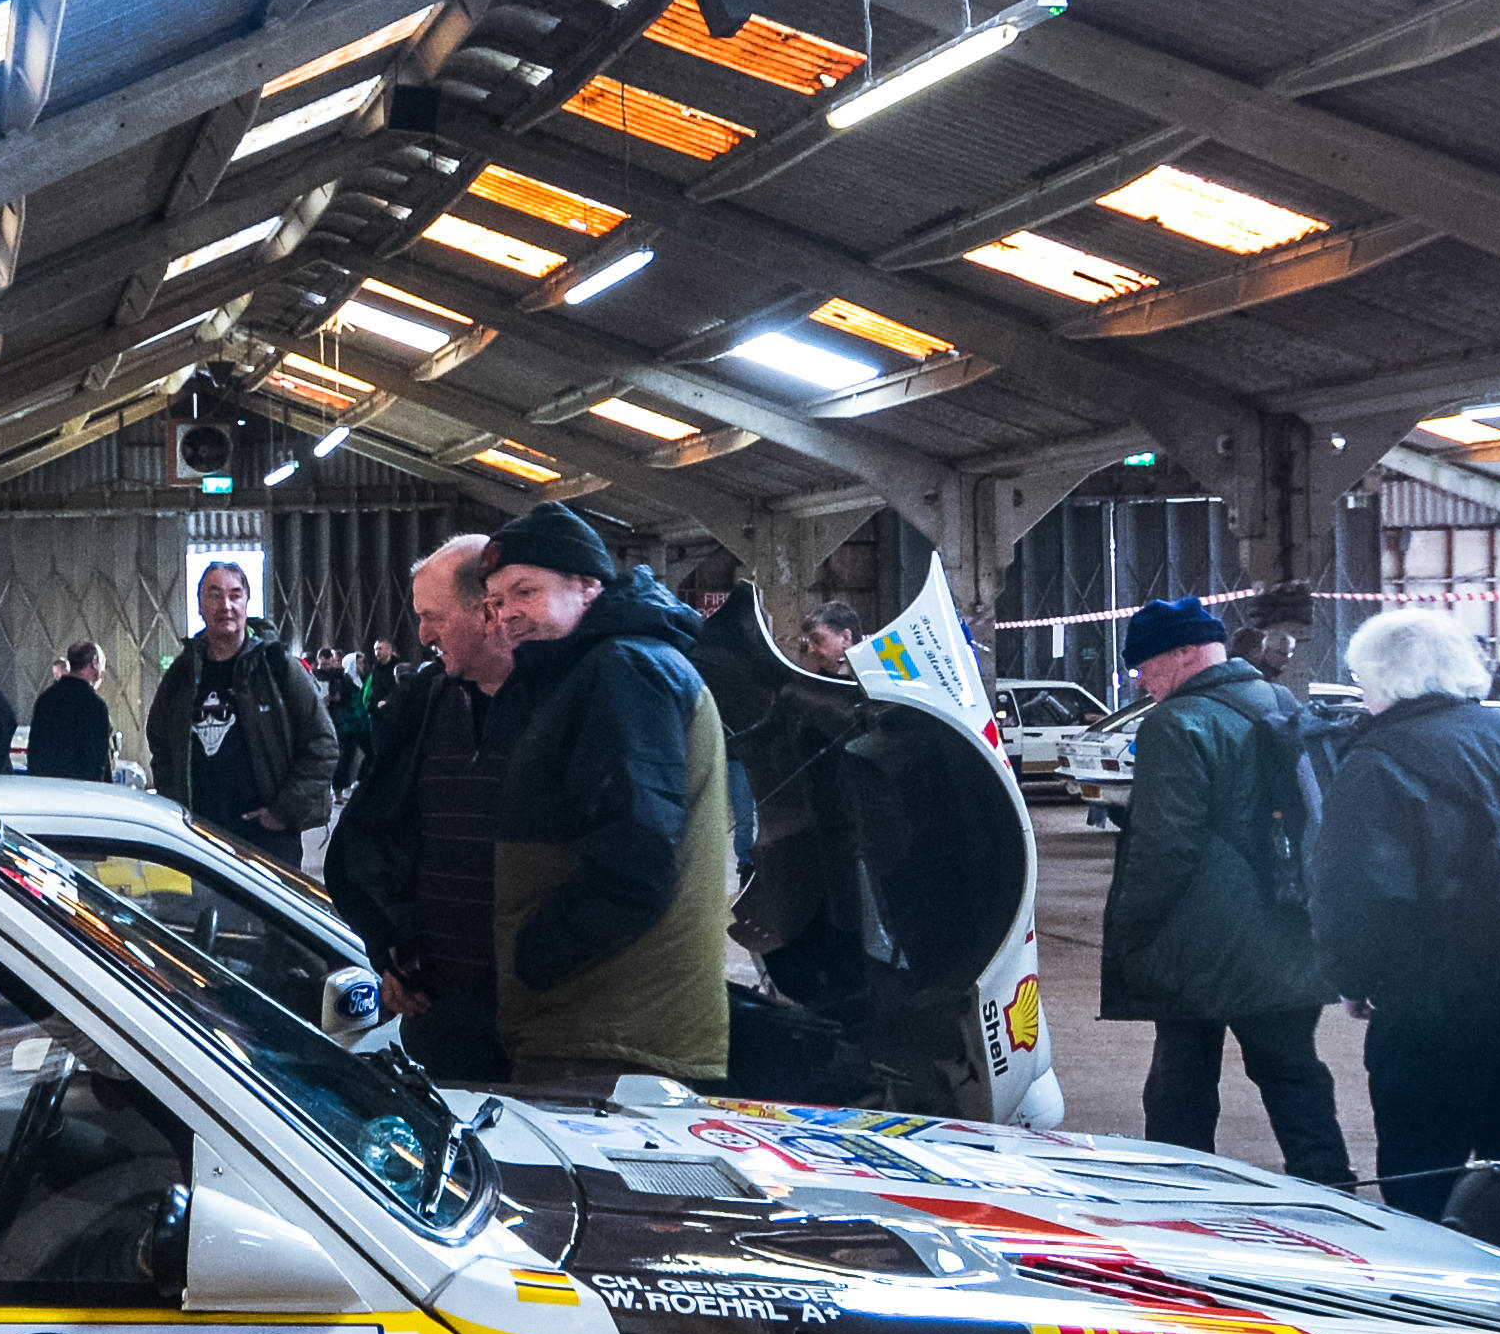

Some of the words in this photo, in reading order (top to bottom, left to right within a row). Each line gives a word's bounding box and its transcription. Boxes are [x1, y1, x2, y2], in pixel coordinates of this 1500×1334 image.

[704, 592, 730, 606] FIR
[910, 623, 925, 647] Stig
[349, 987, 376, 1014] Ford
[983, 1000, 1008, 1076] Shell
[591, 1274, 651, 1290] CH.
[600, 1289, 643, 1310] W.
[649, 1292, 789, 1322] ROEHRL
